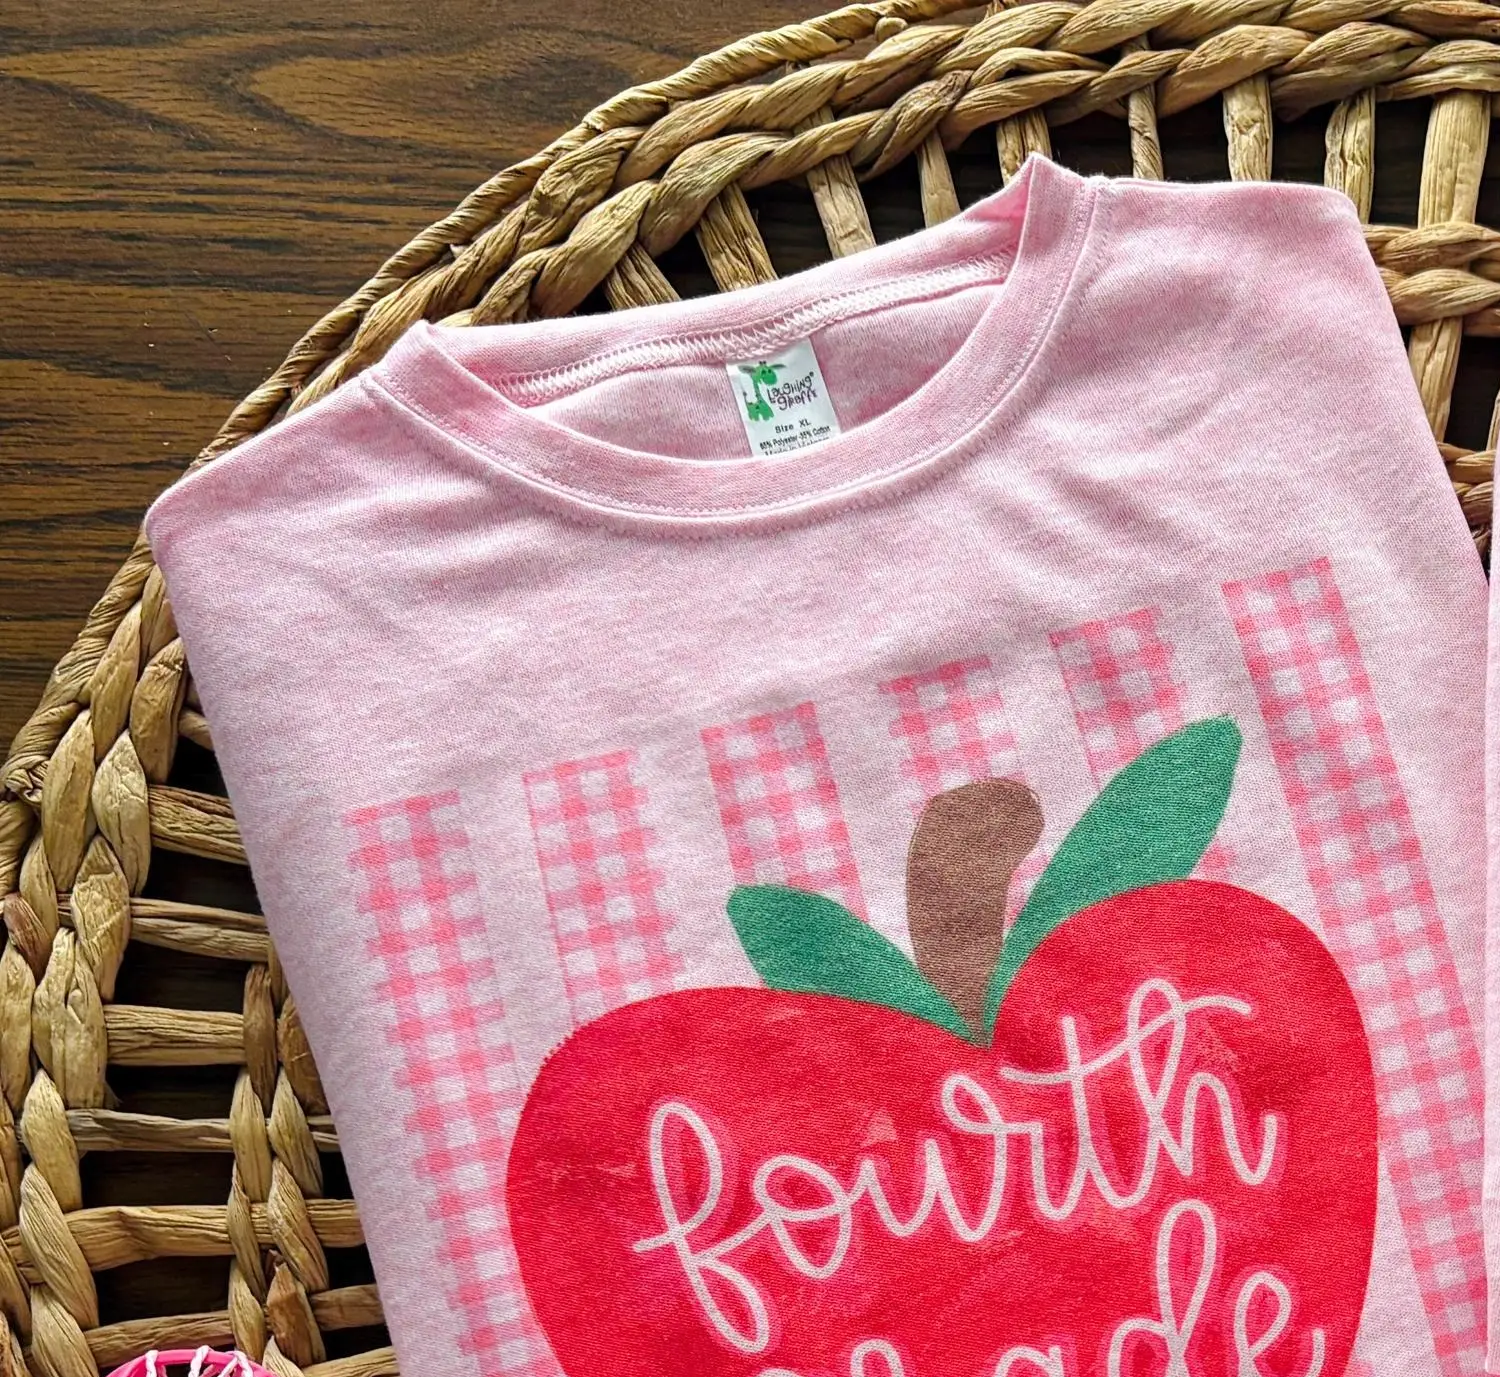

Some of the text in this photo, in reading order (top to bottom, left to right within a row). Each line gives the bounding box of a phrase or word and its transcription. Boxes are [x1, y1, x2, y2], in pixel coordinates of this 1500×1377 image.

[775, 418, 811, 434] Size XL
[632, 978, 1278, 1354] fourth
